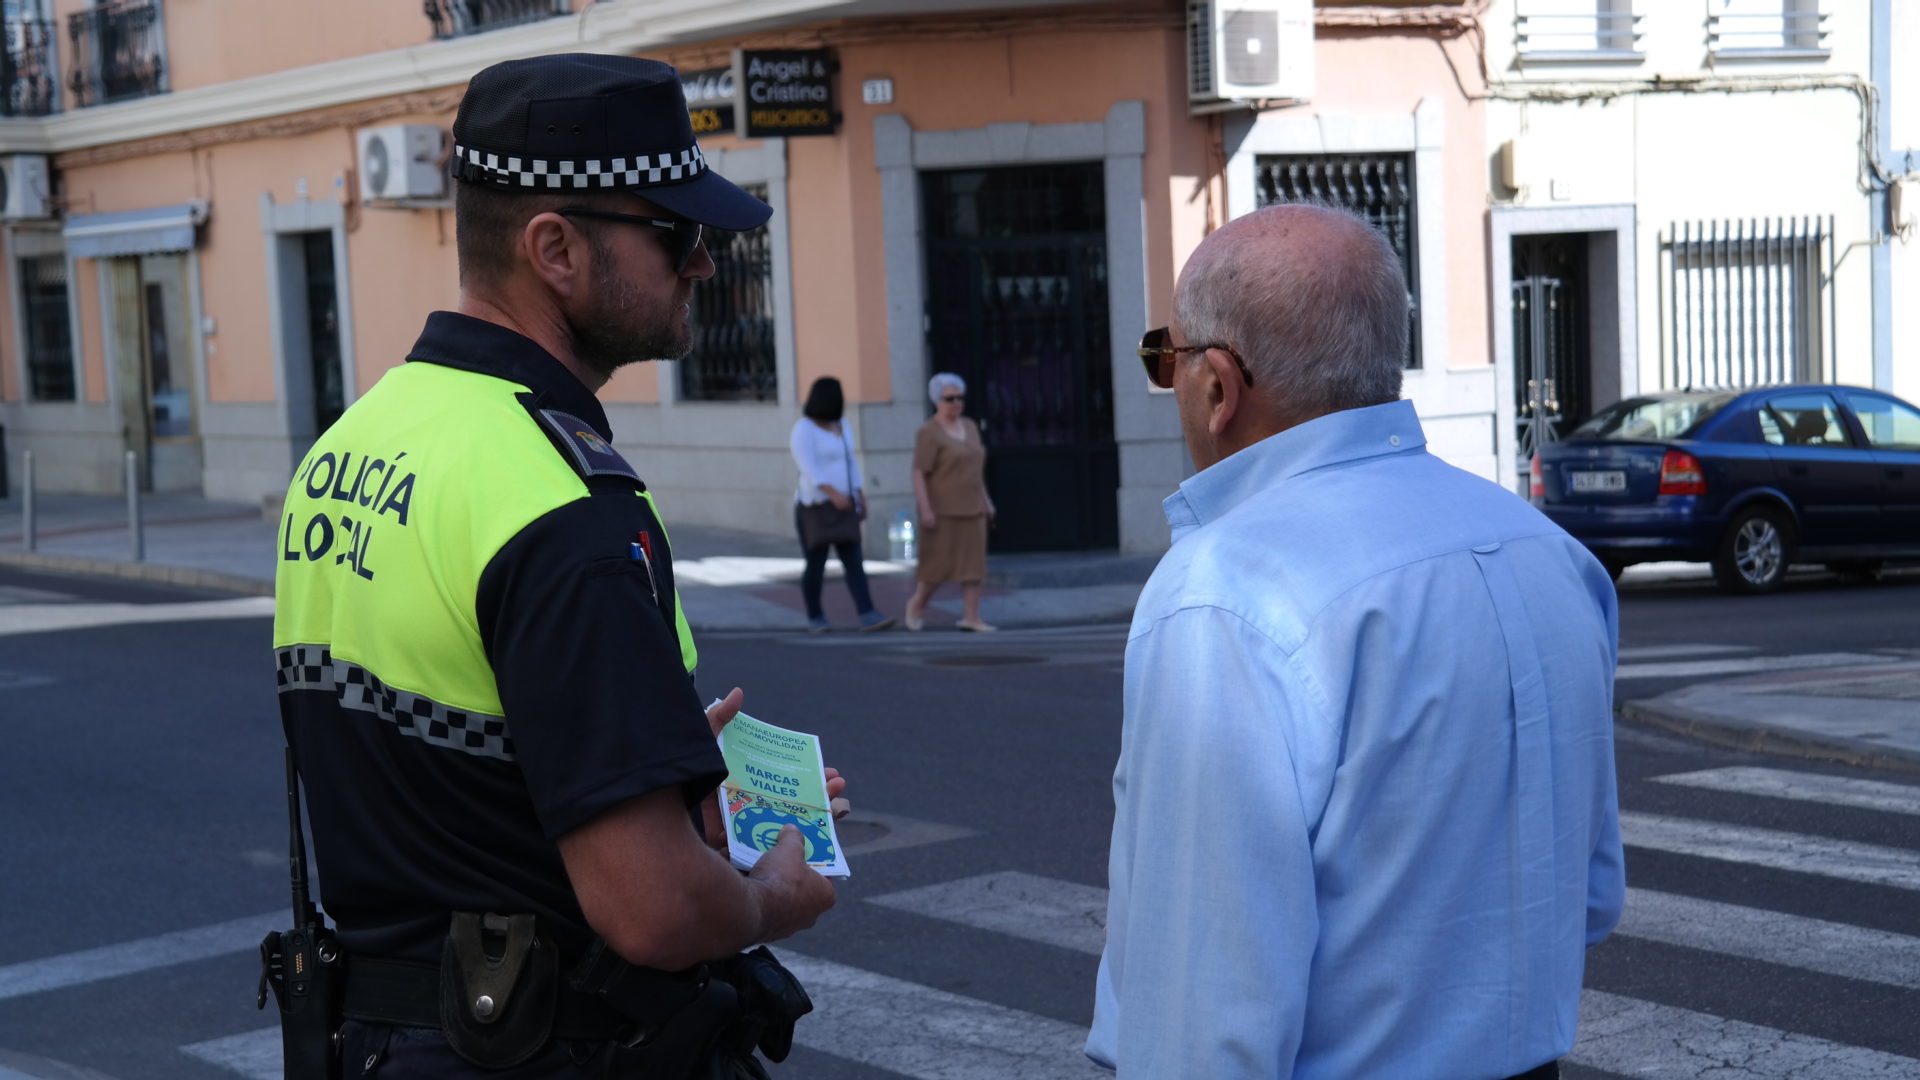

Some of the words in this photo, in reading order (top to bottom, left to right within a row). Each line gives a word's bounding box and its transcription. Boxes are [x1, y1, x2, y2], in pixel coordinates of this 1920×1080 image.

[748, 56, 809, 82] Angel
[750, 80, 828, 103] Cristina
[734, 717, 808, 746] EMANAEUROPEA
[745, 764, 800, 786] MARCAS
[750, 777, 797, 797] VIALES
